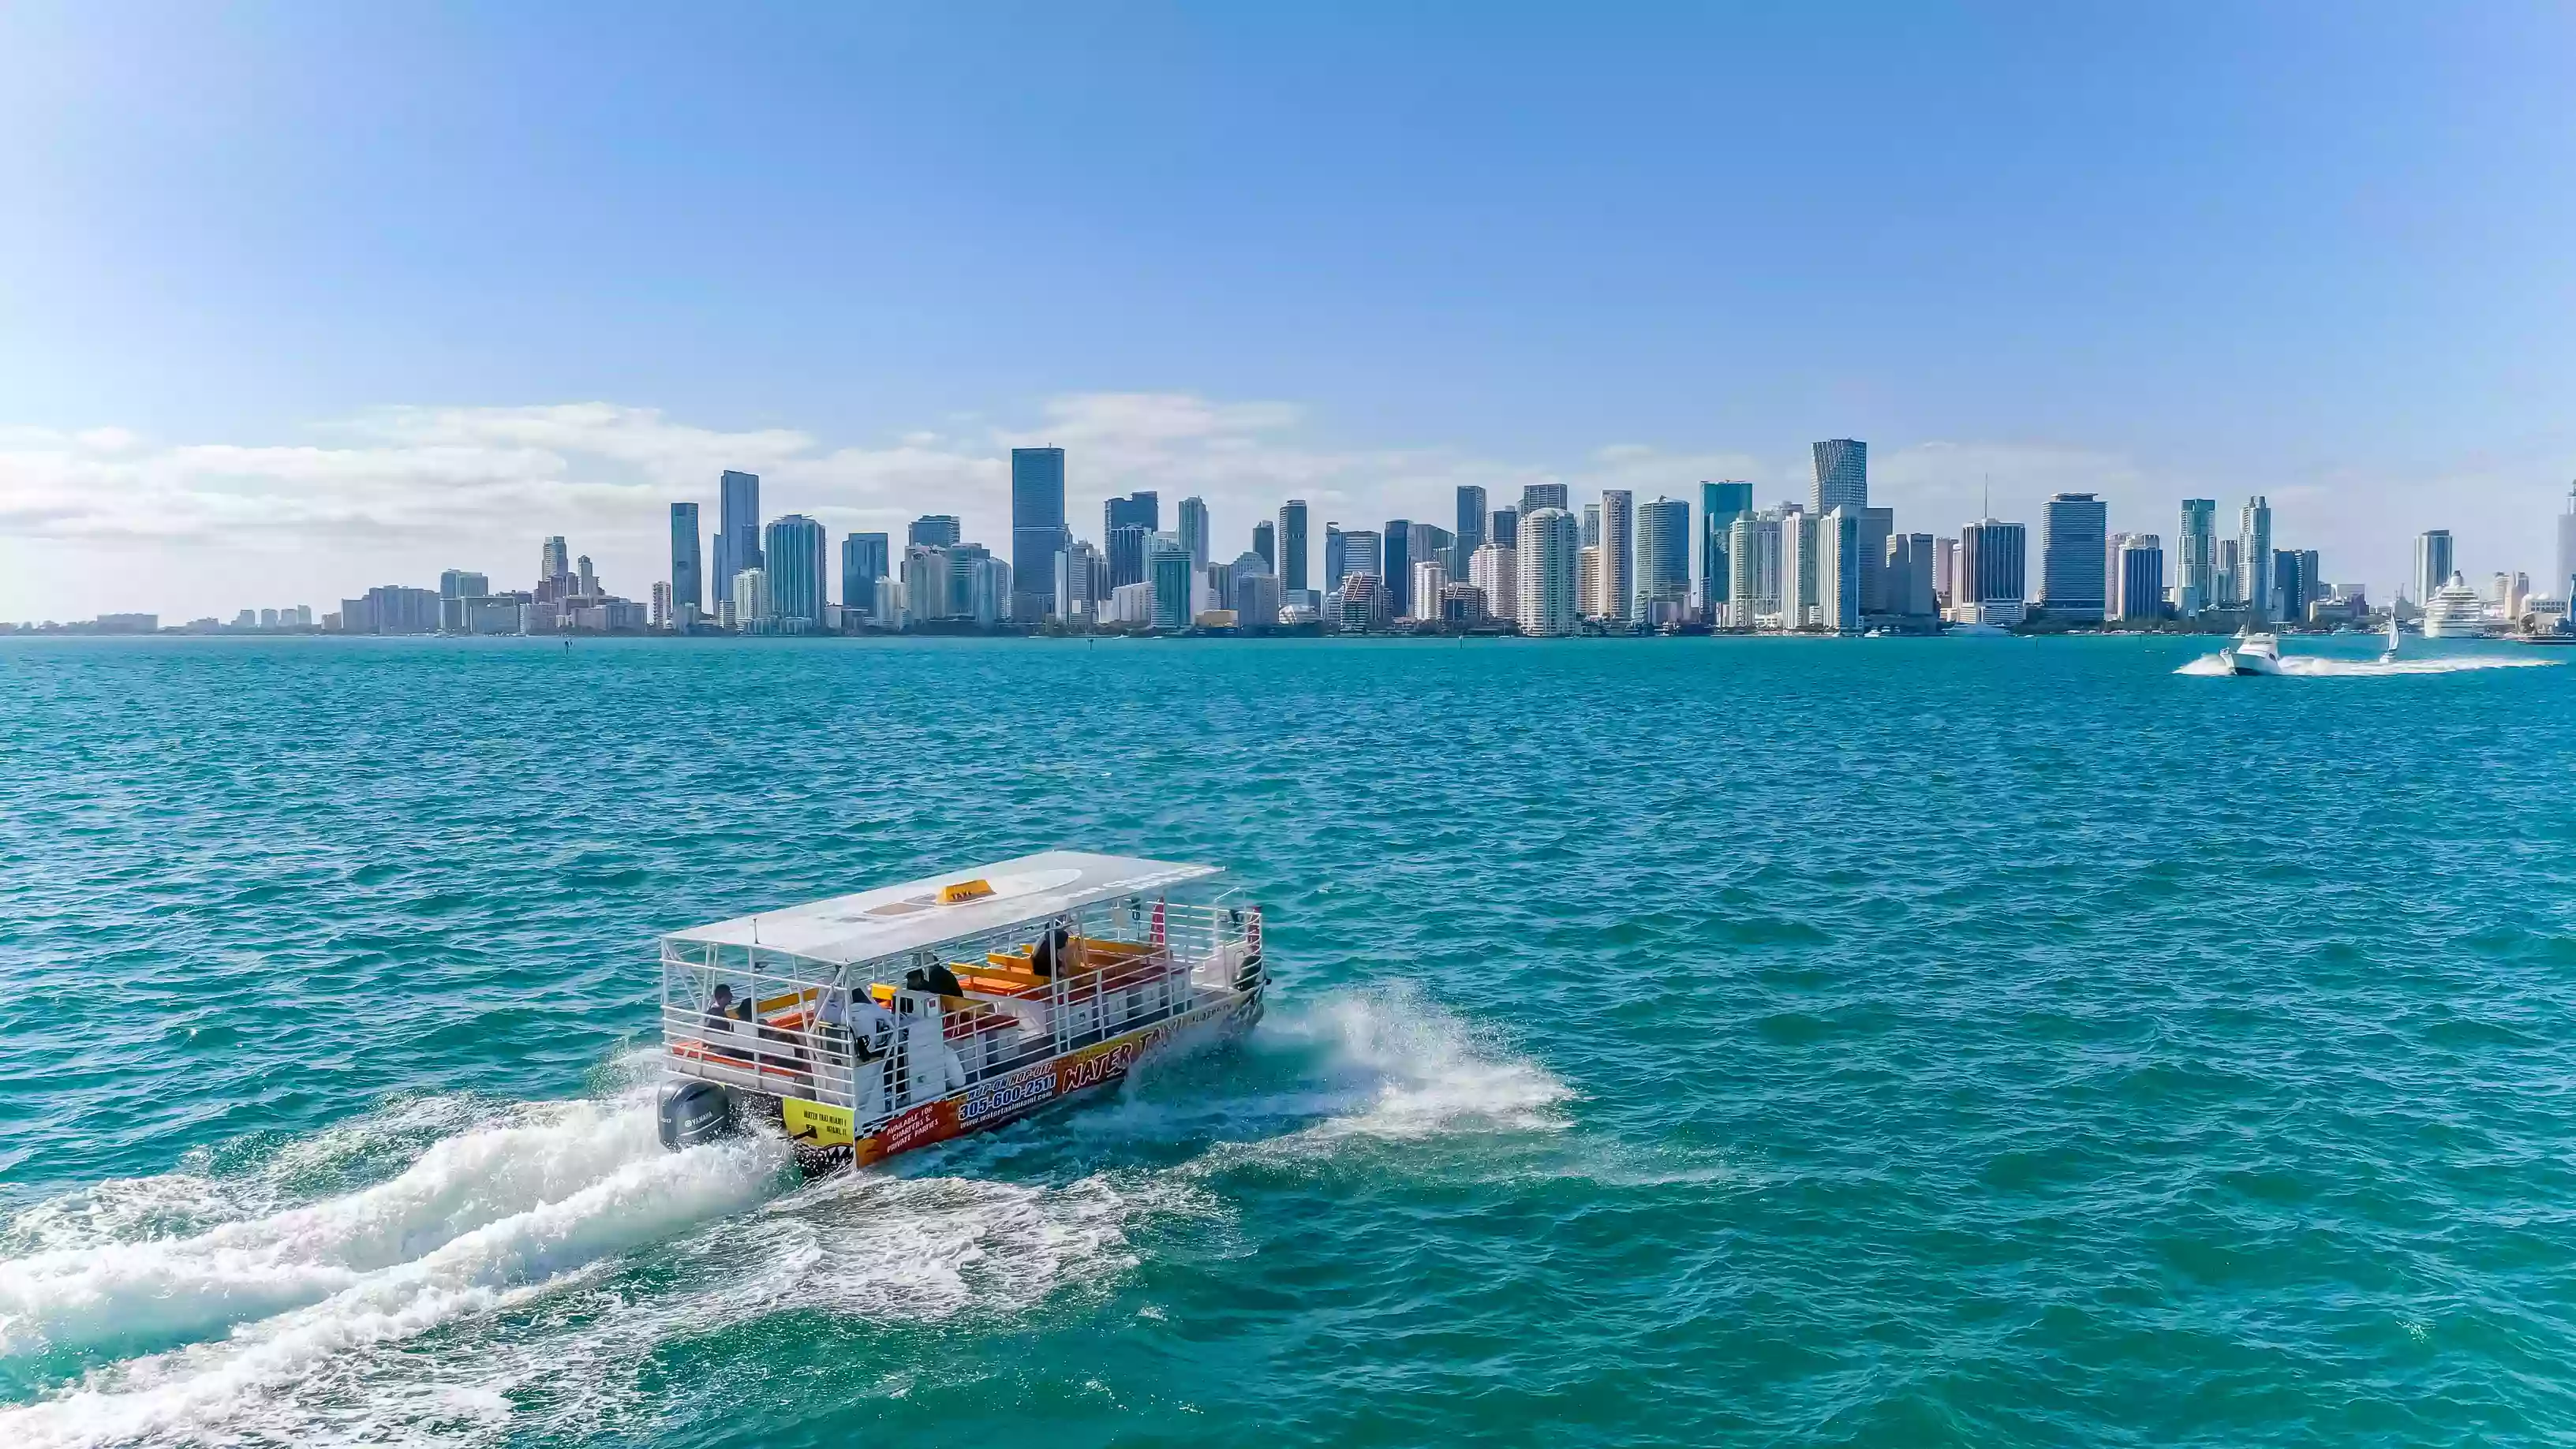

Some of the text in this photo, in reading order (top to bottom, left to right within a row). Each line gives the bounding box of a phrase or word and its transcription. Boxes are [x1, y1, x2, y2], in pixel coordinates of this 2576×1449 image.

[1062, 1043, 1133, 1094] WATER
[959, 1073, 1056, 1121] 305-600-2511
[959, 1090, 1052, 1130] www.watertaximiami.com
[691, 1111, 713, 1126] YAMAHA
[887, 1105, 933, 1136] AVAILABLE FOR
[887, 1118, 939, 1153] PRIVATE PARTIES
[892, 1118, 924, 1141] CHARTERS
